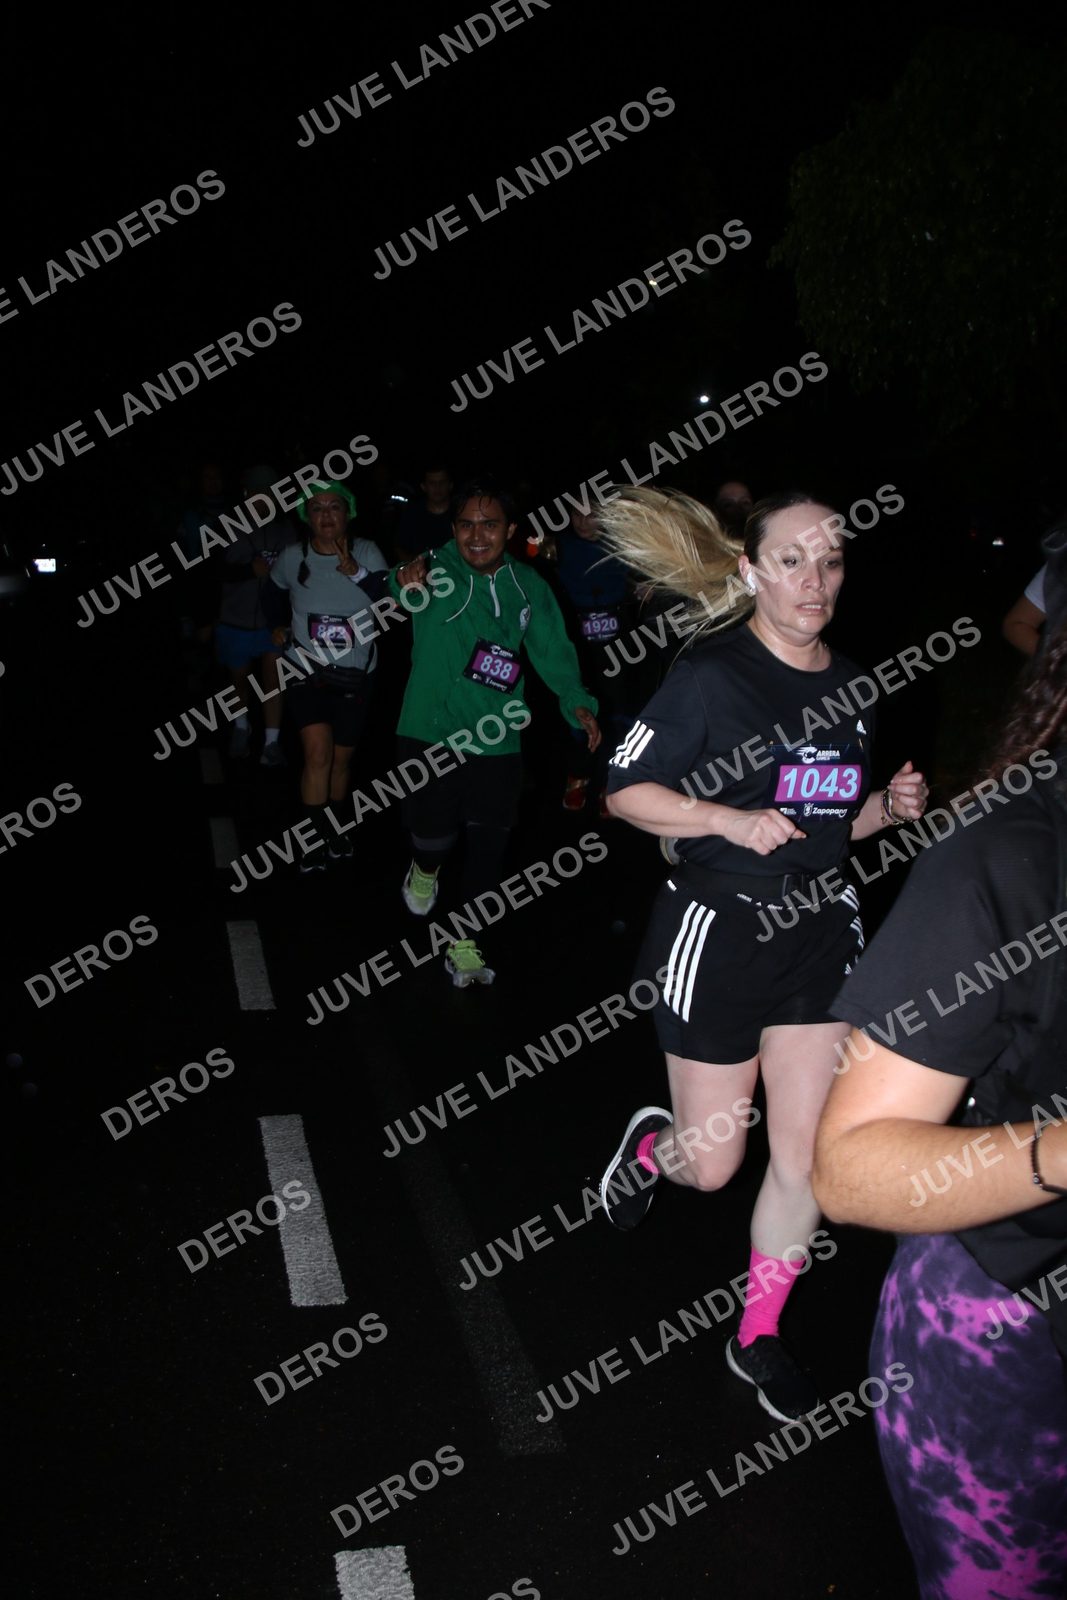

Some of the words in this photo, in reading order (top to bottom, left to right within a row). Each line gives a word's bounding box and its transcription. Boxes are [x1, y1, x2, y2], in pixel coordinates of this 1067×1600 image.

[584, 618, 618, 634] 1920
[480, 655, 513, 680] 838
[784, 768, 858, 799] 1043
